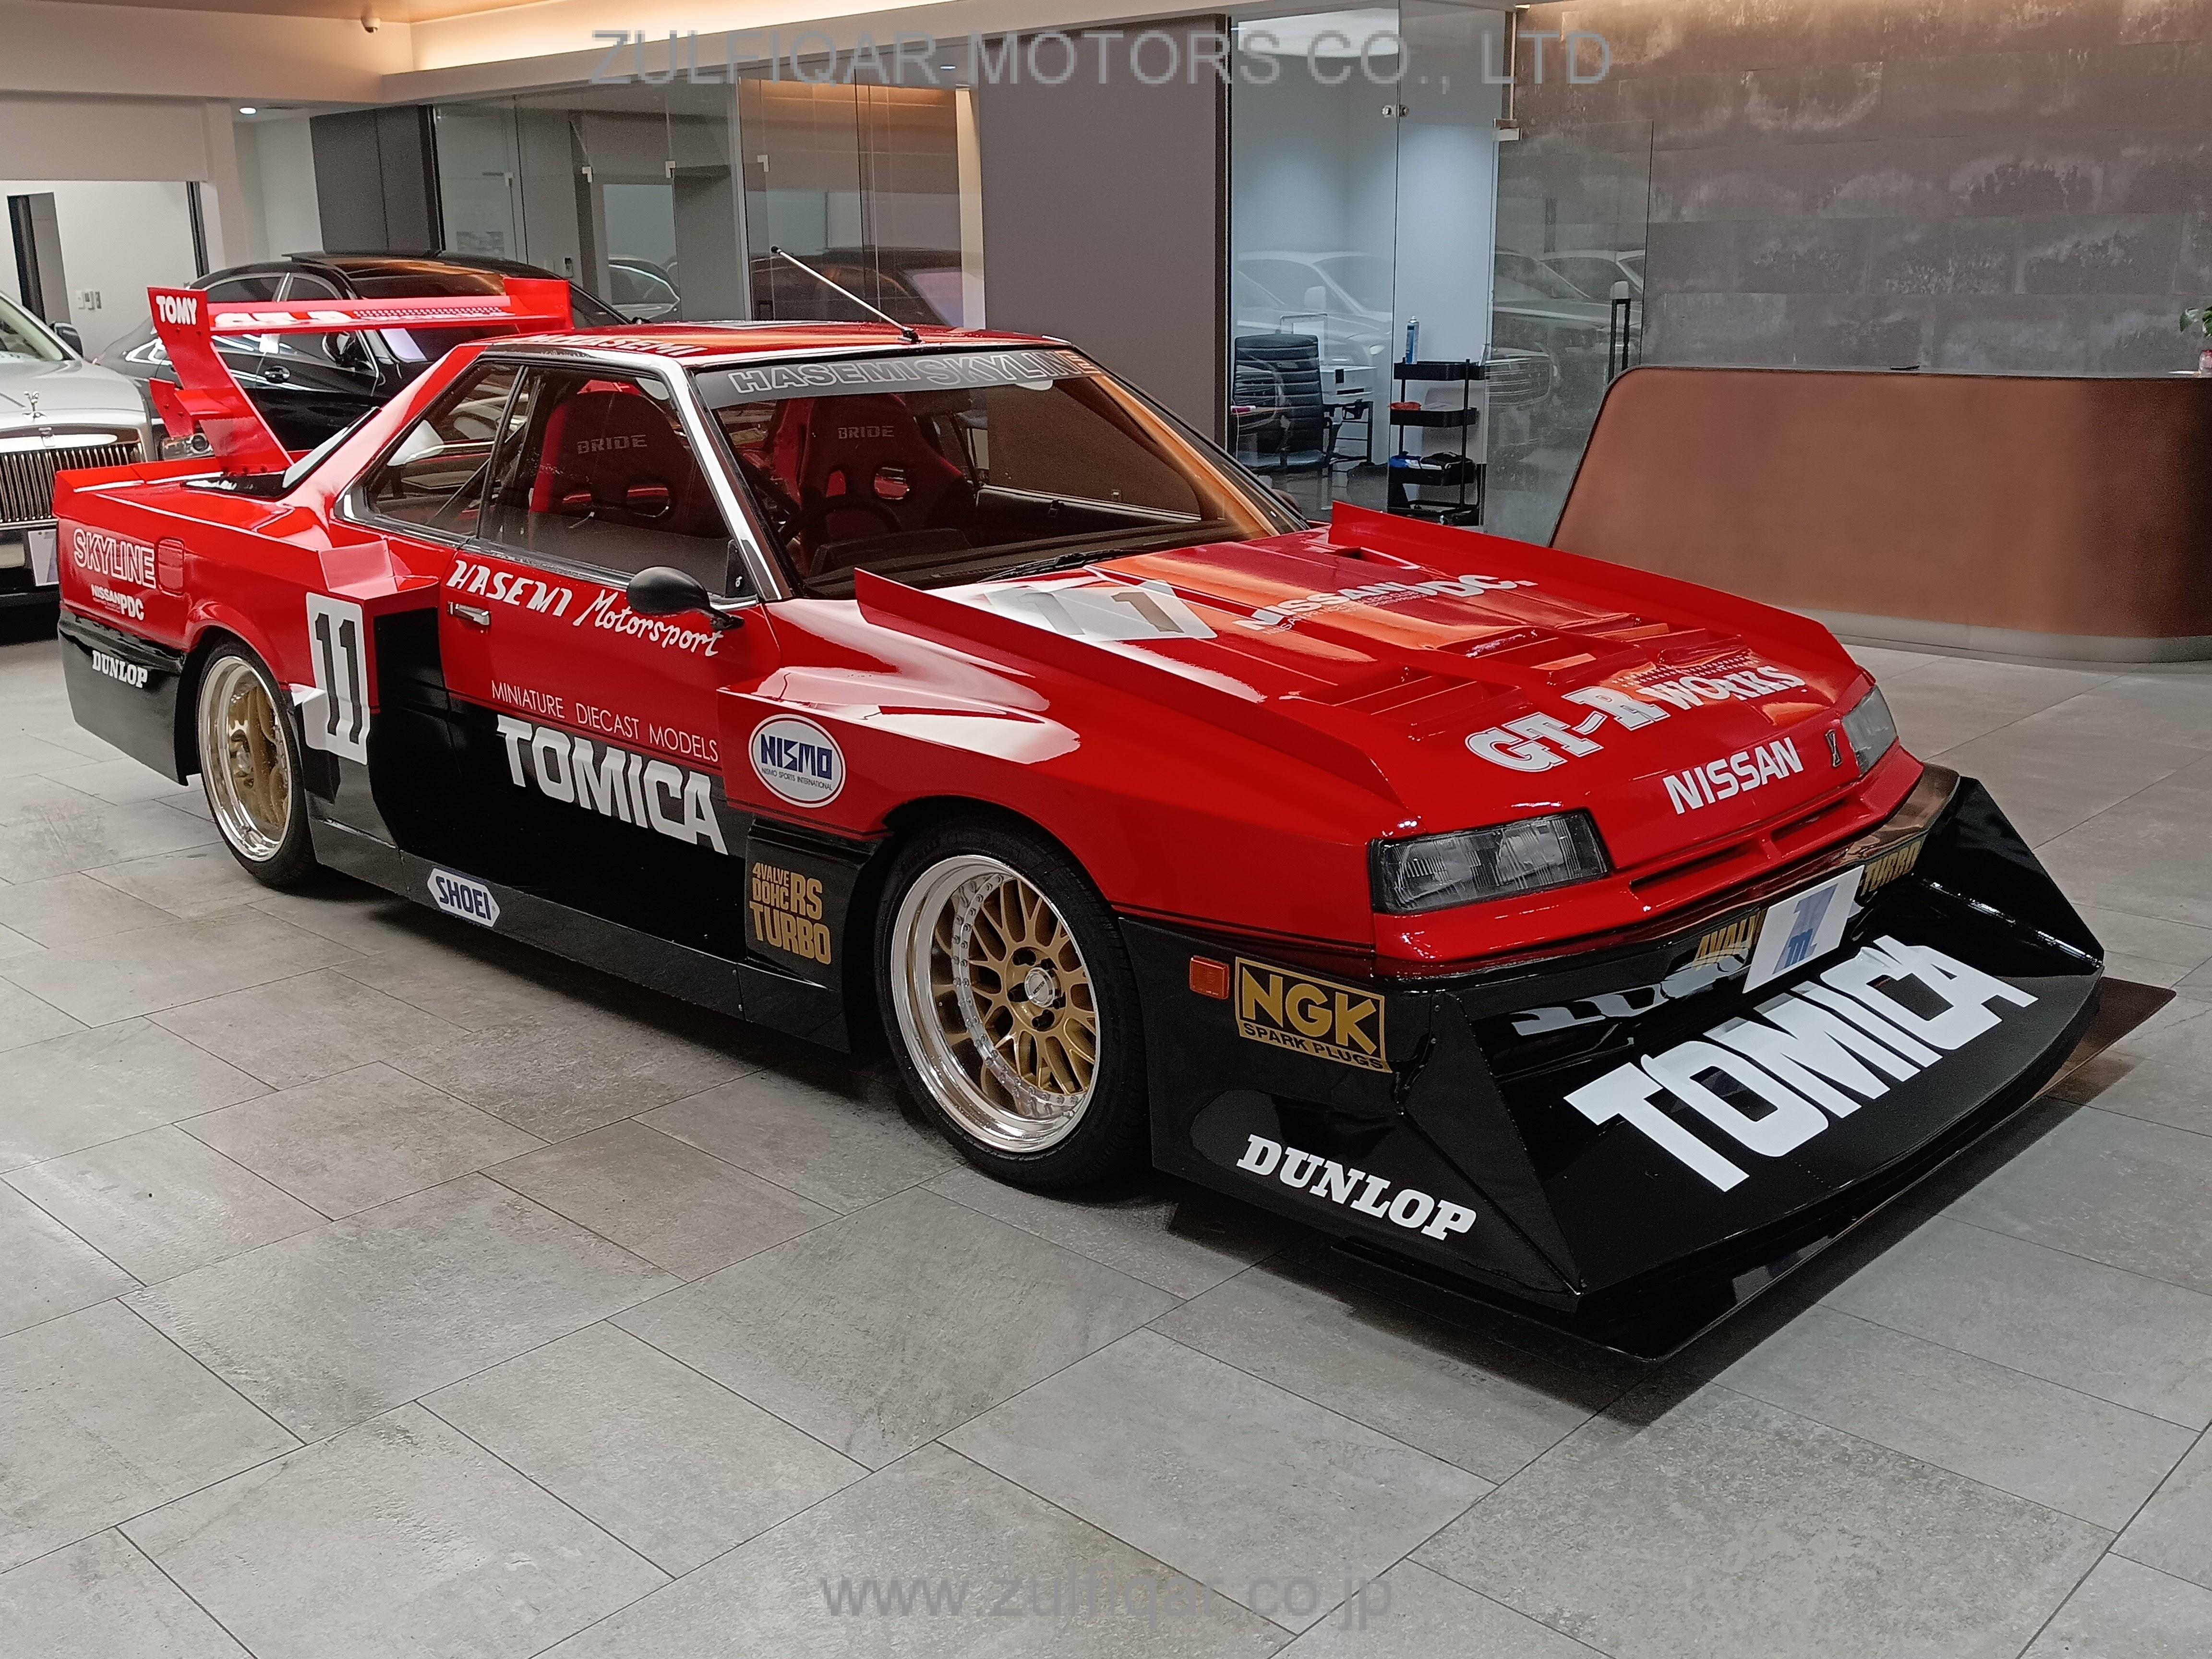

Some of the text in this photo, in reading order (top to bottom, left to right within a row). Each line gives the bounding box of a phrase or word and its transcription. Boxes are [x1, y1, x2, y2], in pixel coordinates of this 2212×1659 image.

[156, 295, 197, 325] TOMY
[728, 349, 1102, 394] HASEMI SKYLINE
[577, 434, 648, 454] BRIDE
[837, 426, 895, 439] BRIDE
[73, 528, 156, 589] SKYLINE
[91, 584, 121, 604] NISSAN
[120, 593, 144, 621] PDC
[446, 560, 724, 657] HASEMI Motorsport
[92, 650, 148, 688] DUNLOP
[314, 612, 362, 745] 11
[491, 680, 719, 763] MINIATURE DIECAST MODELS
[1465, 665, 1806, 772] GT-R WORKS
[760, 733, 833, 781] NISMO
[761, 768, 833, 791] NISMO SPORTS INTERNATIONAL
[1662, 736, 1804, 815] NISSAN
[497, 714, 729, 855] TOMICA
[435, 876, 492, 921] SHOEI
[752, 862, 790, 887] 4VALVE
[752, 877, 789, 911] DOHC
[790, 872, 823, 920] RS
[749, 901, 832, 965] TURBO
[1242, 967, 1377, 1055] NGK
[1245, 1023, 1384, 1070] SPARK PLUGS
[1563, 935, 2039, 1192] TOMICA
[1236, 1134, 1477, 1240] DUNLOP
